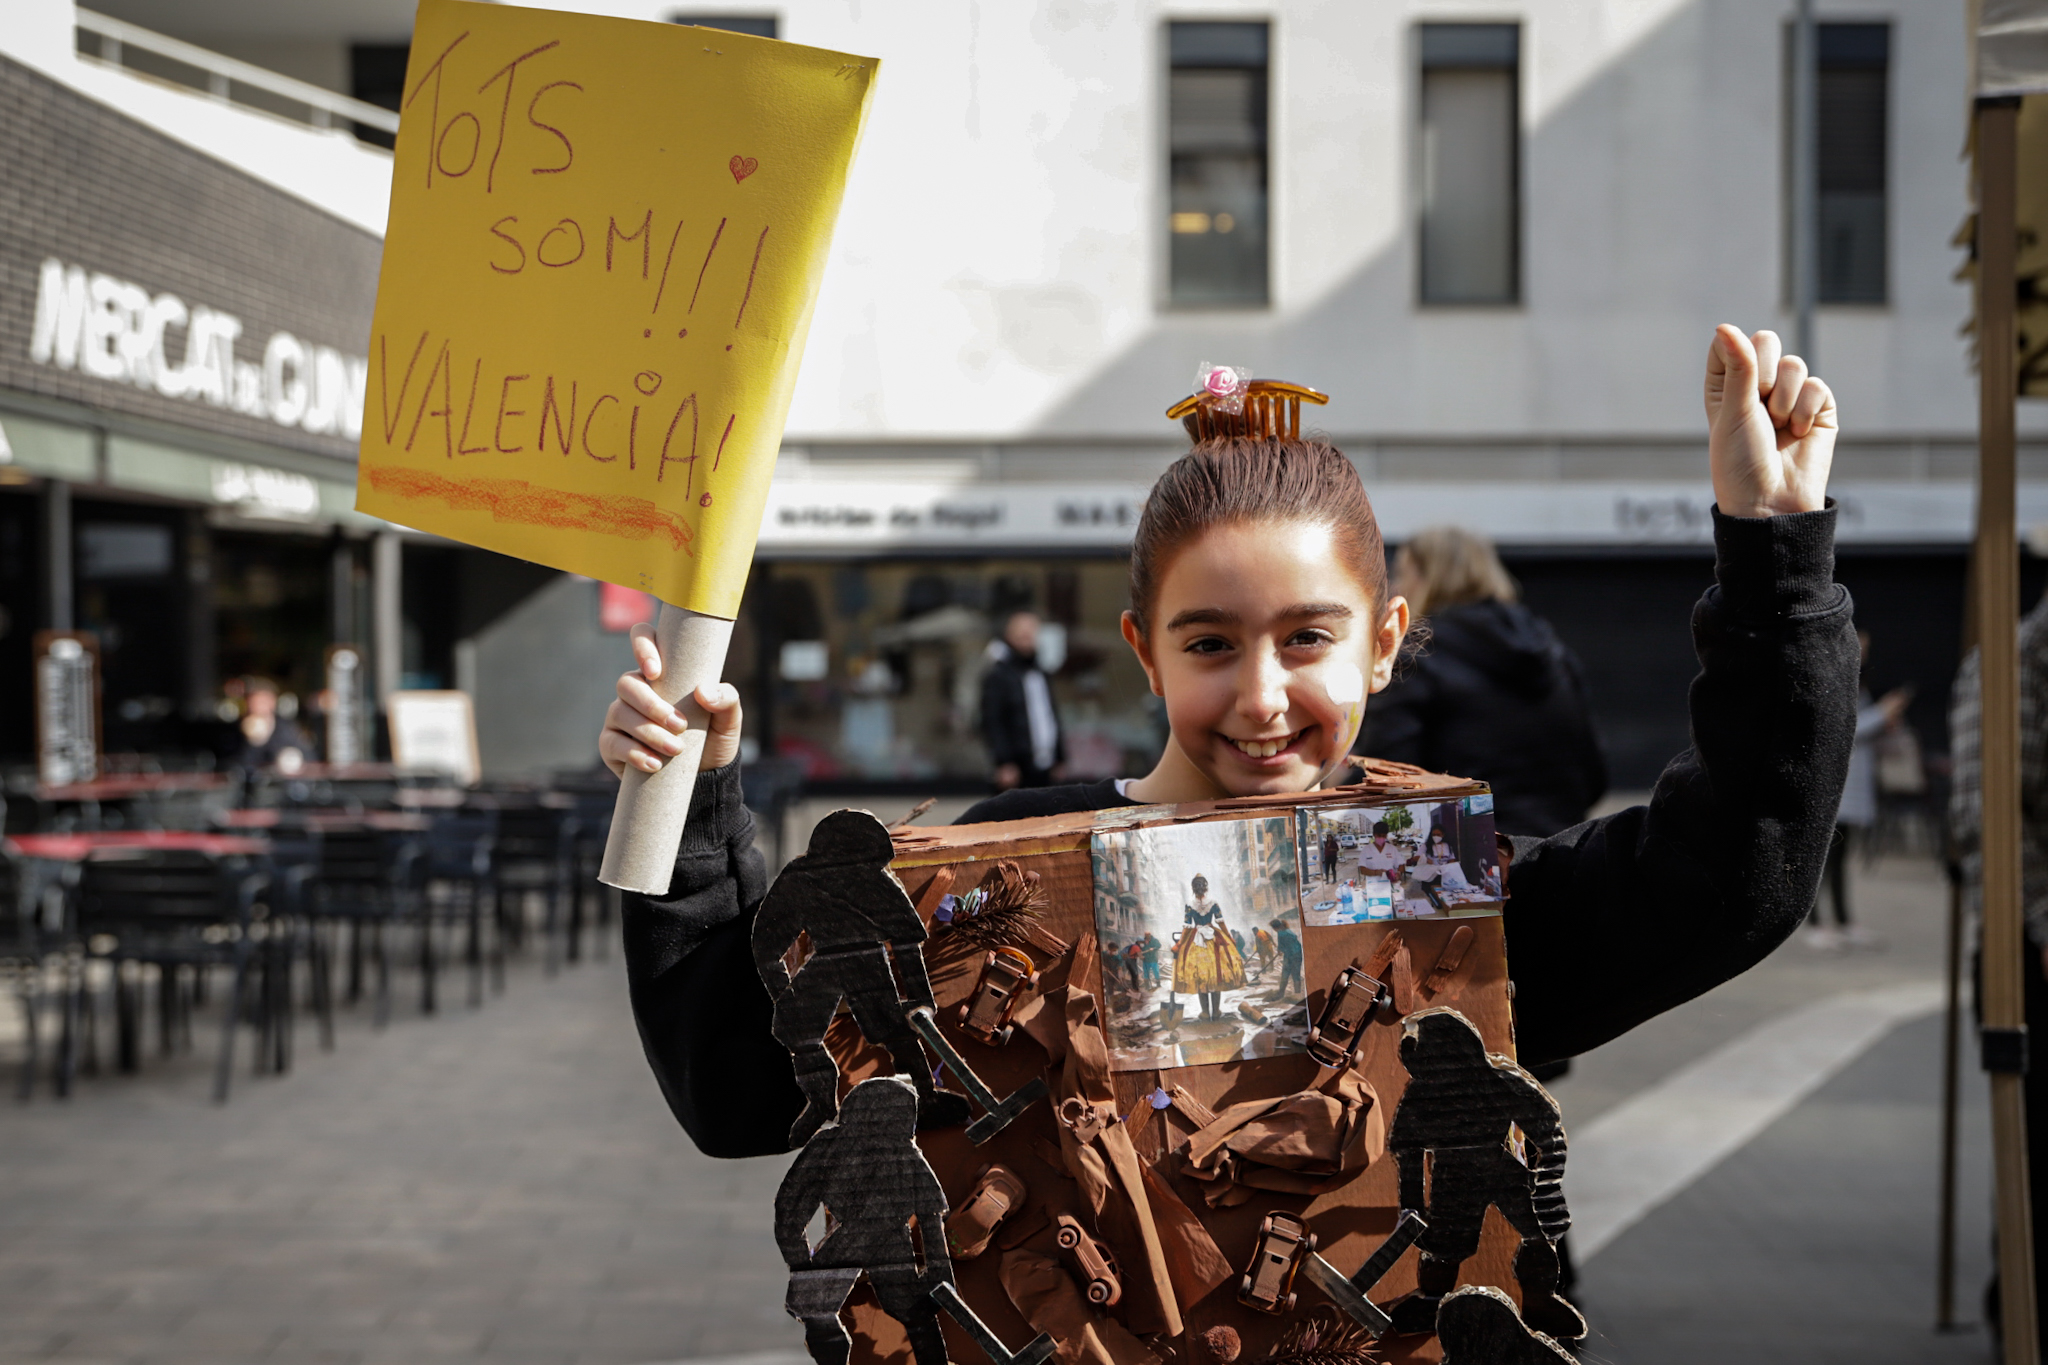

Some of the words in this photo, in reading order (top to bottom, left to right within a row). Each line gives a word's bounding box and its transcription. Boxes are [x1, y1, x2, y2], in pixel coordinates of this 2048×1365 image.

[30, 257, 243, 409] MERCAT
[262, 331, 367, 441] CUN
[489, 209, 769, 352] SOM!!!
